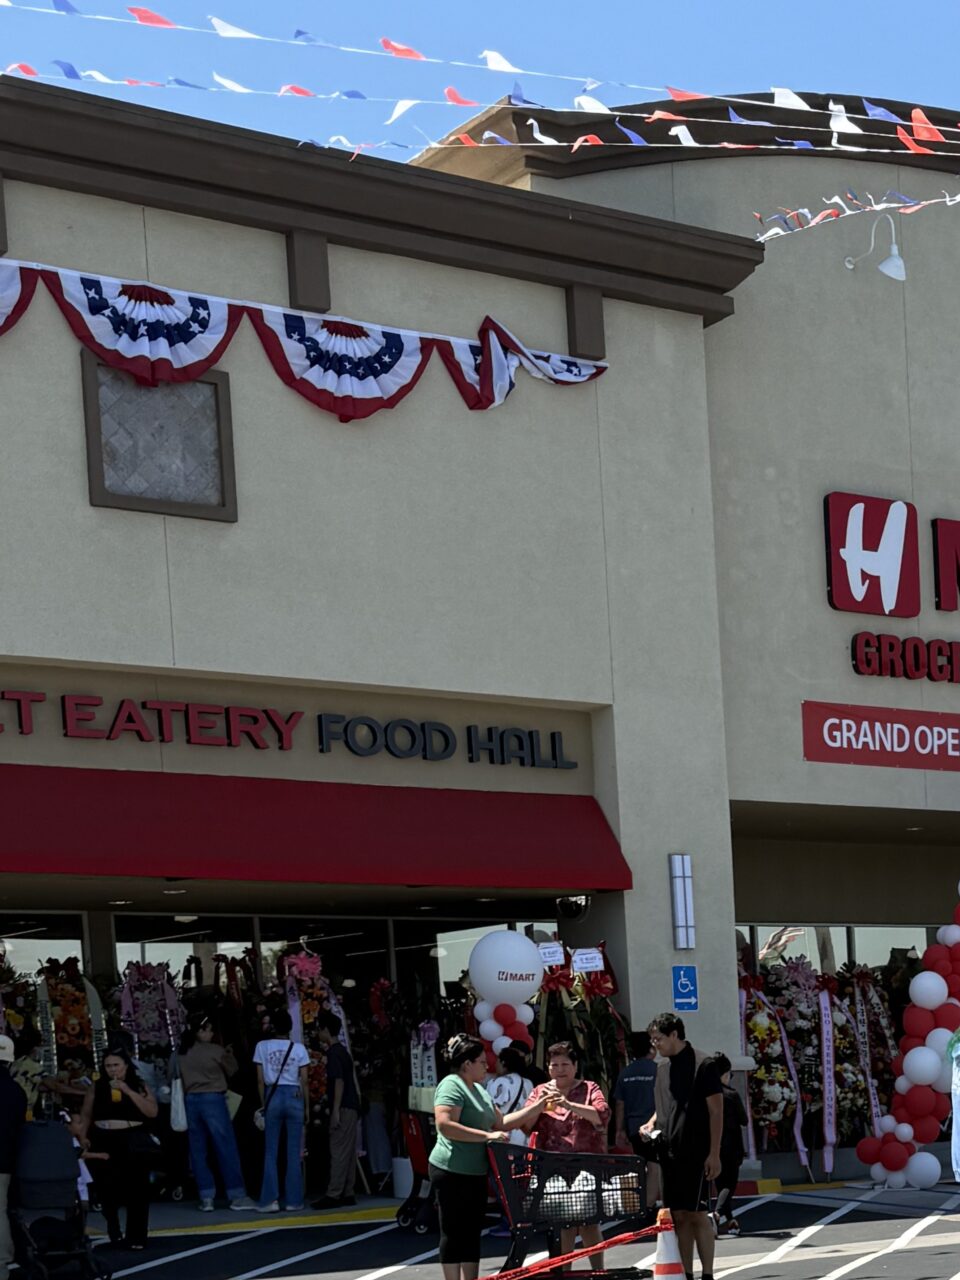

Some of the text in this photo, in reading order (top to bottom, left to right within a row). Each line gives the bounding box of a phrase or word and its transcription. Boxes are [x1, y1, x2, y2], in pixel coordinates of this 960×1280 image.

[837, 499, 910, 616] H
[0, 690, 578, 769] T EATERY FOOD HALL
[822, 717, 910, 752] GRAND
[509, 973, 536, 982] MART
[824, 1031, 833, 1126] INTERNATIONAL
